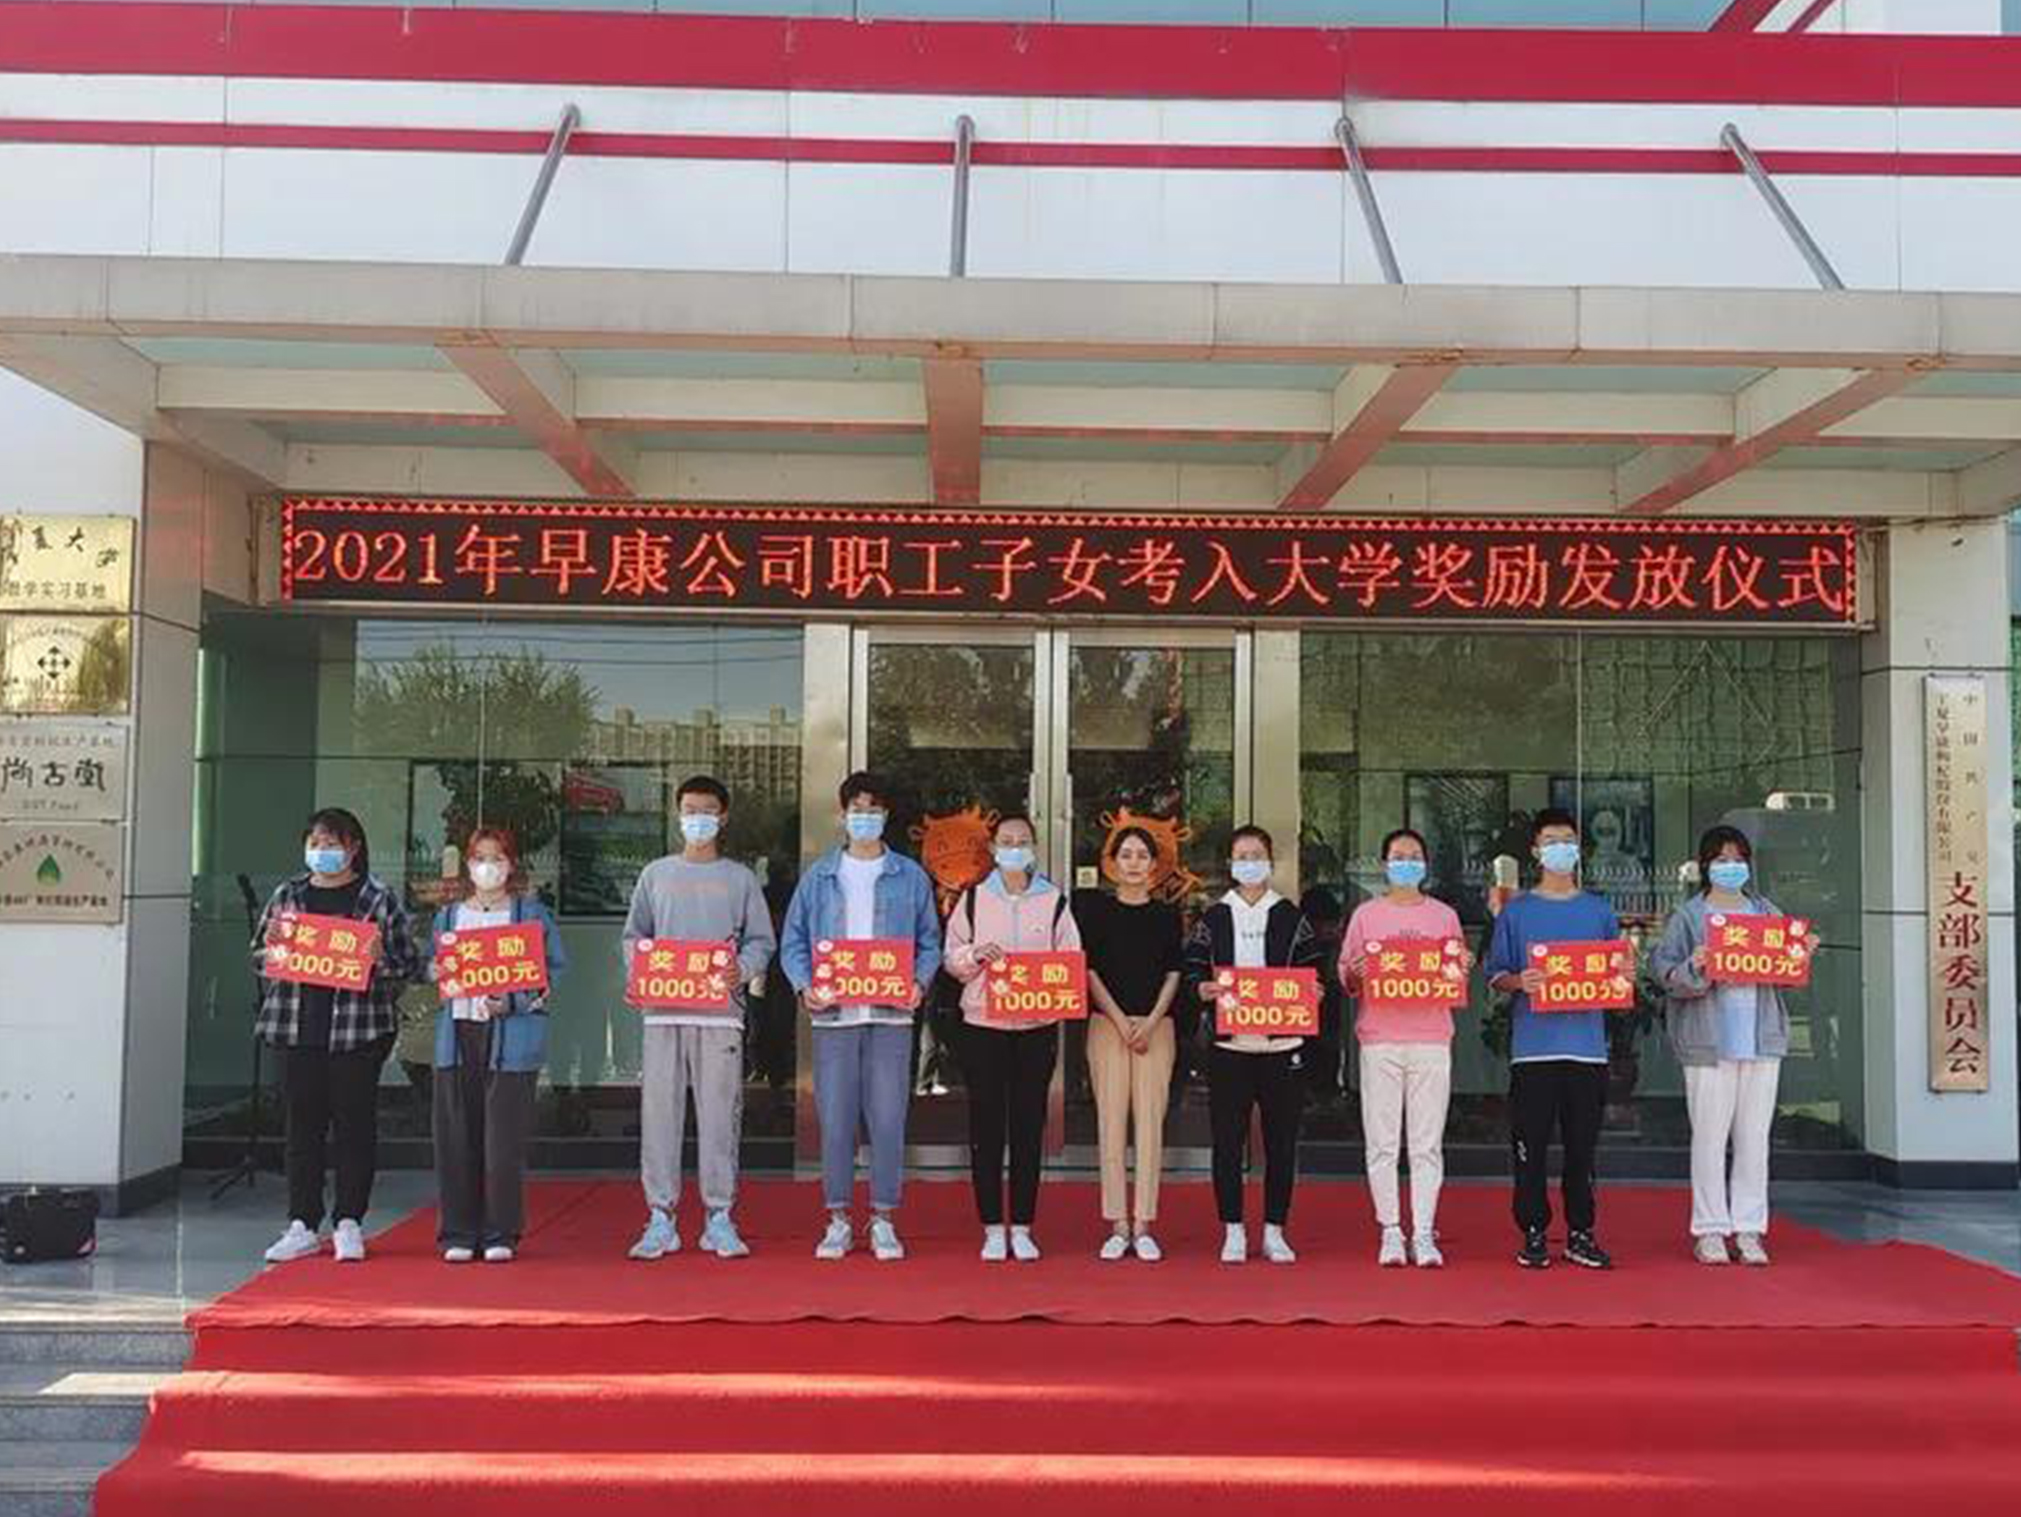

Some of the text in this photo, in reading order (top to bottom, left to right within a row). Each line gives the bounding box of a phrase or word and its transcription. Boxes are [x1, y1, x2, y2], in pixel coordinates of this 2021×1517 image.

[293, 523, 1844, 612] 2021年早康公司职工子女考入大学奖励发放仪式
[287, 952, 362, 981] 000元
[462, 960, 540, 988] 000元
[1714, 952, 1802, 976] 1000元
[1937, 871, 1981, 1073] 支部委员会
[835, 976, 907, 998] 000元
[1370, 977, 1459, 999] 1000元
[995, 989, 1081, 1012] 1000元
[1226, 1004, 1312, 1027] 1000元
